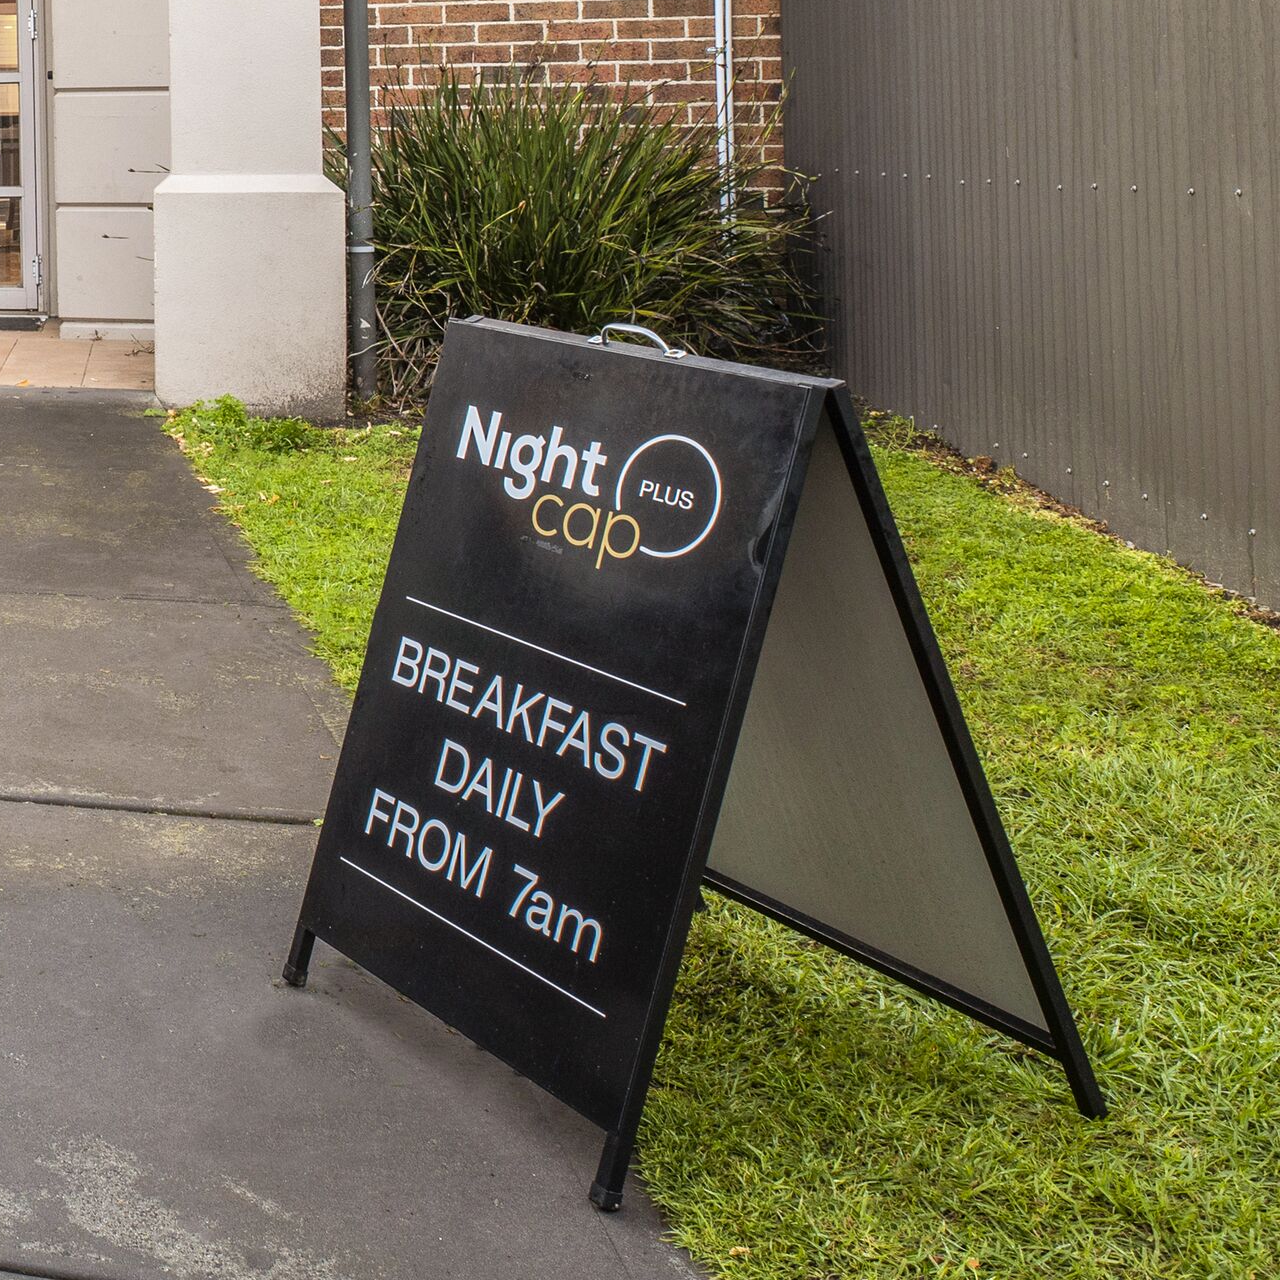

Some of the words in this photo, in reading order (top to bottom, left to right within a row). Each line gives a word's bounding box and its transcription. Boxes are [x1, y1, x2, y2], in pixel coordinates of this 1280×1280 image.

[456, 404, 608, 500] Night
[639, 480, 694, 510] PLUS
[531, 494, 640, 569] cap
[391, 636, 667, 792] BREAKFAST
[435, 738, 565, 837] DAILY
[364, 788, 493, 898] FROM
[509, 864, 604, 963] 7am
